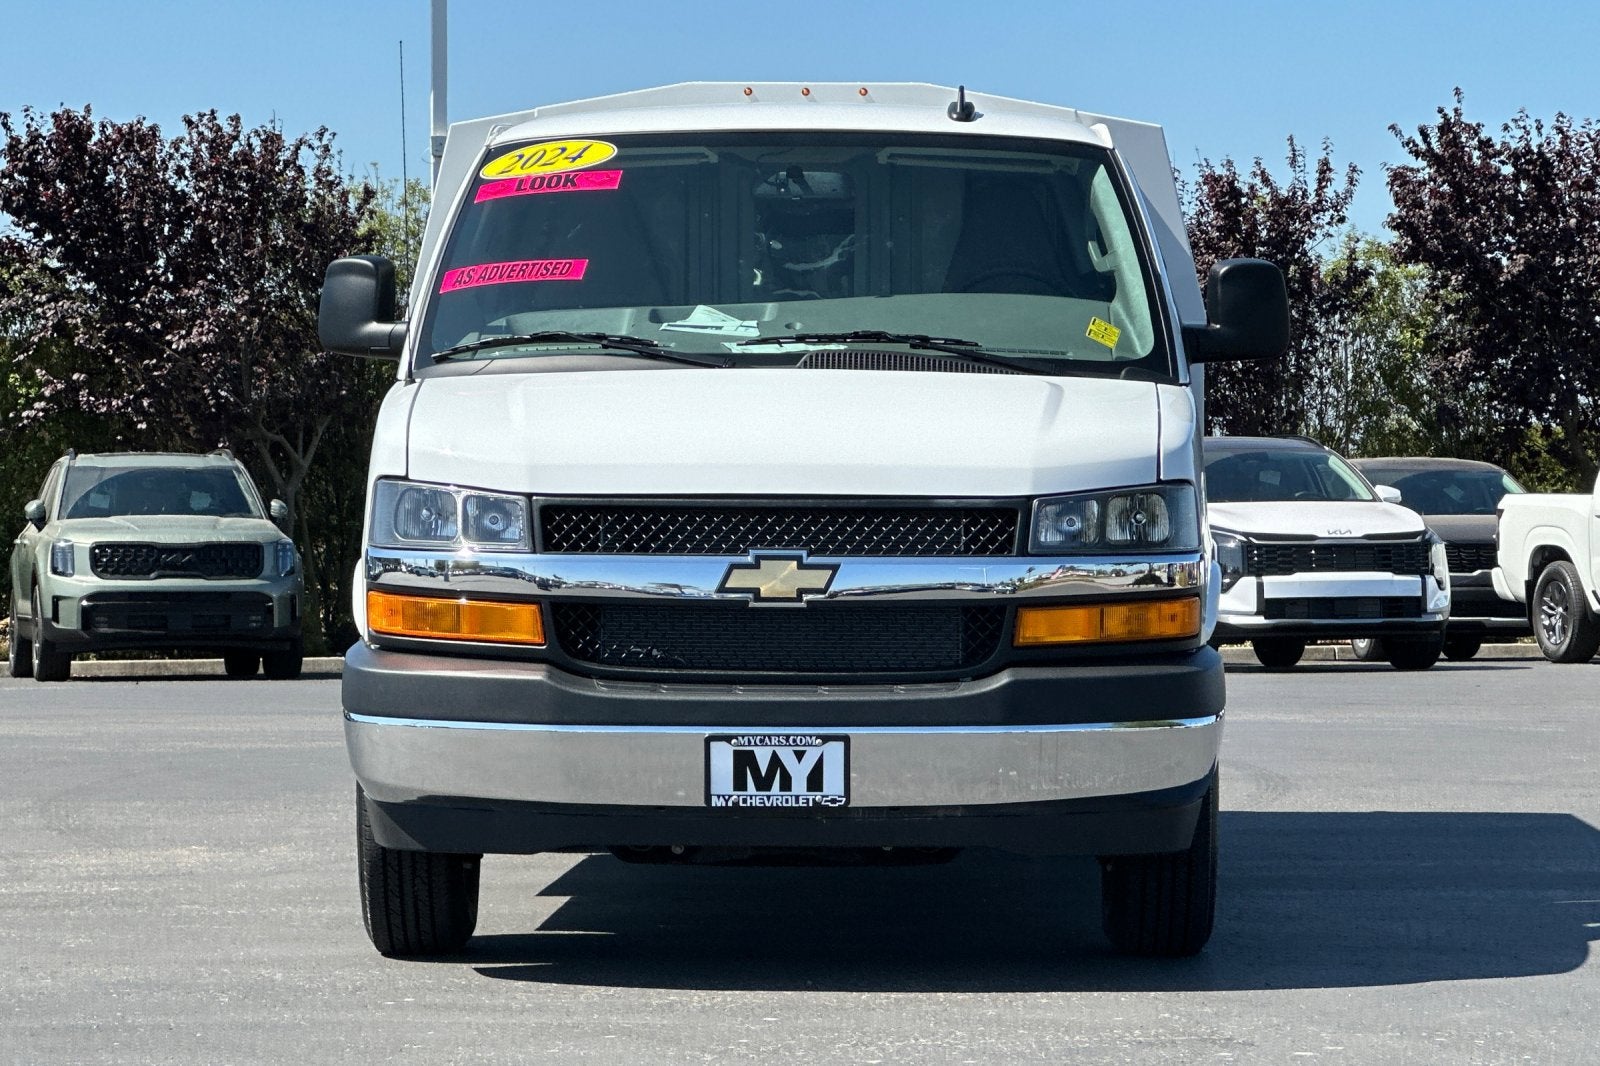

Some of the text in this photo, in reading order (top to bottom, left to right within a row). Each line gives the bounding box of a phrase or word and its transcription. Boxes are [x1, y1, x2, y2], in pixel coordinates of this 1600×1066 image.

[496, 143, 594, 175] 2024
[515, 173, 582, 192] LOOK
[453, 261, 573, 287] AS ADVERTISED
[736, 736, 816, 746] MYCARS.COM
[732, 749, 824, 793] MY
[711, 795, 815, 807] MY CHEVROLET
